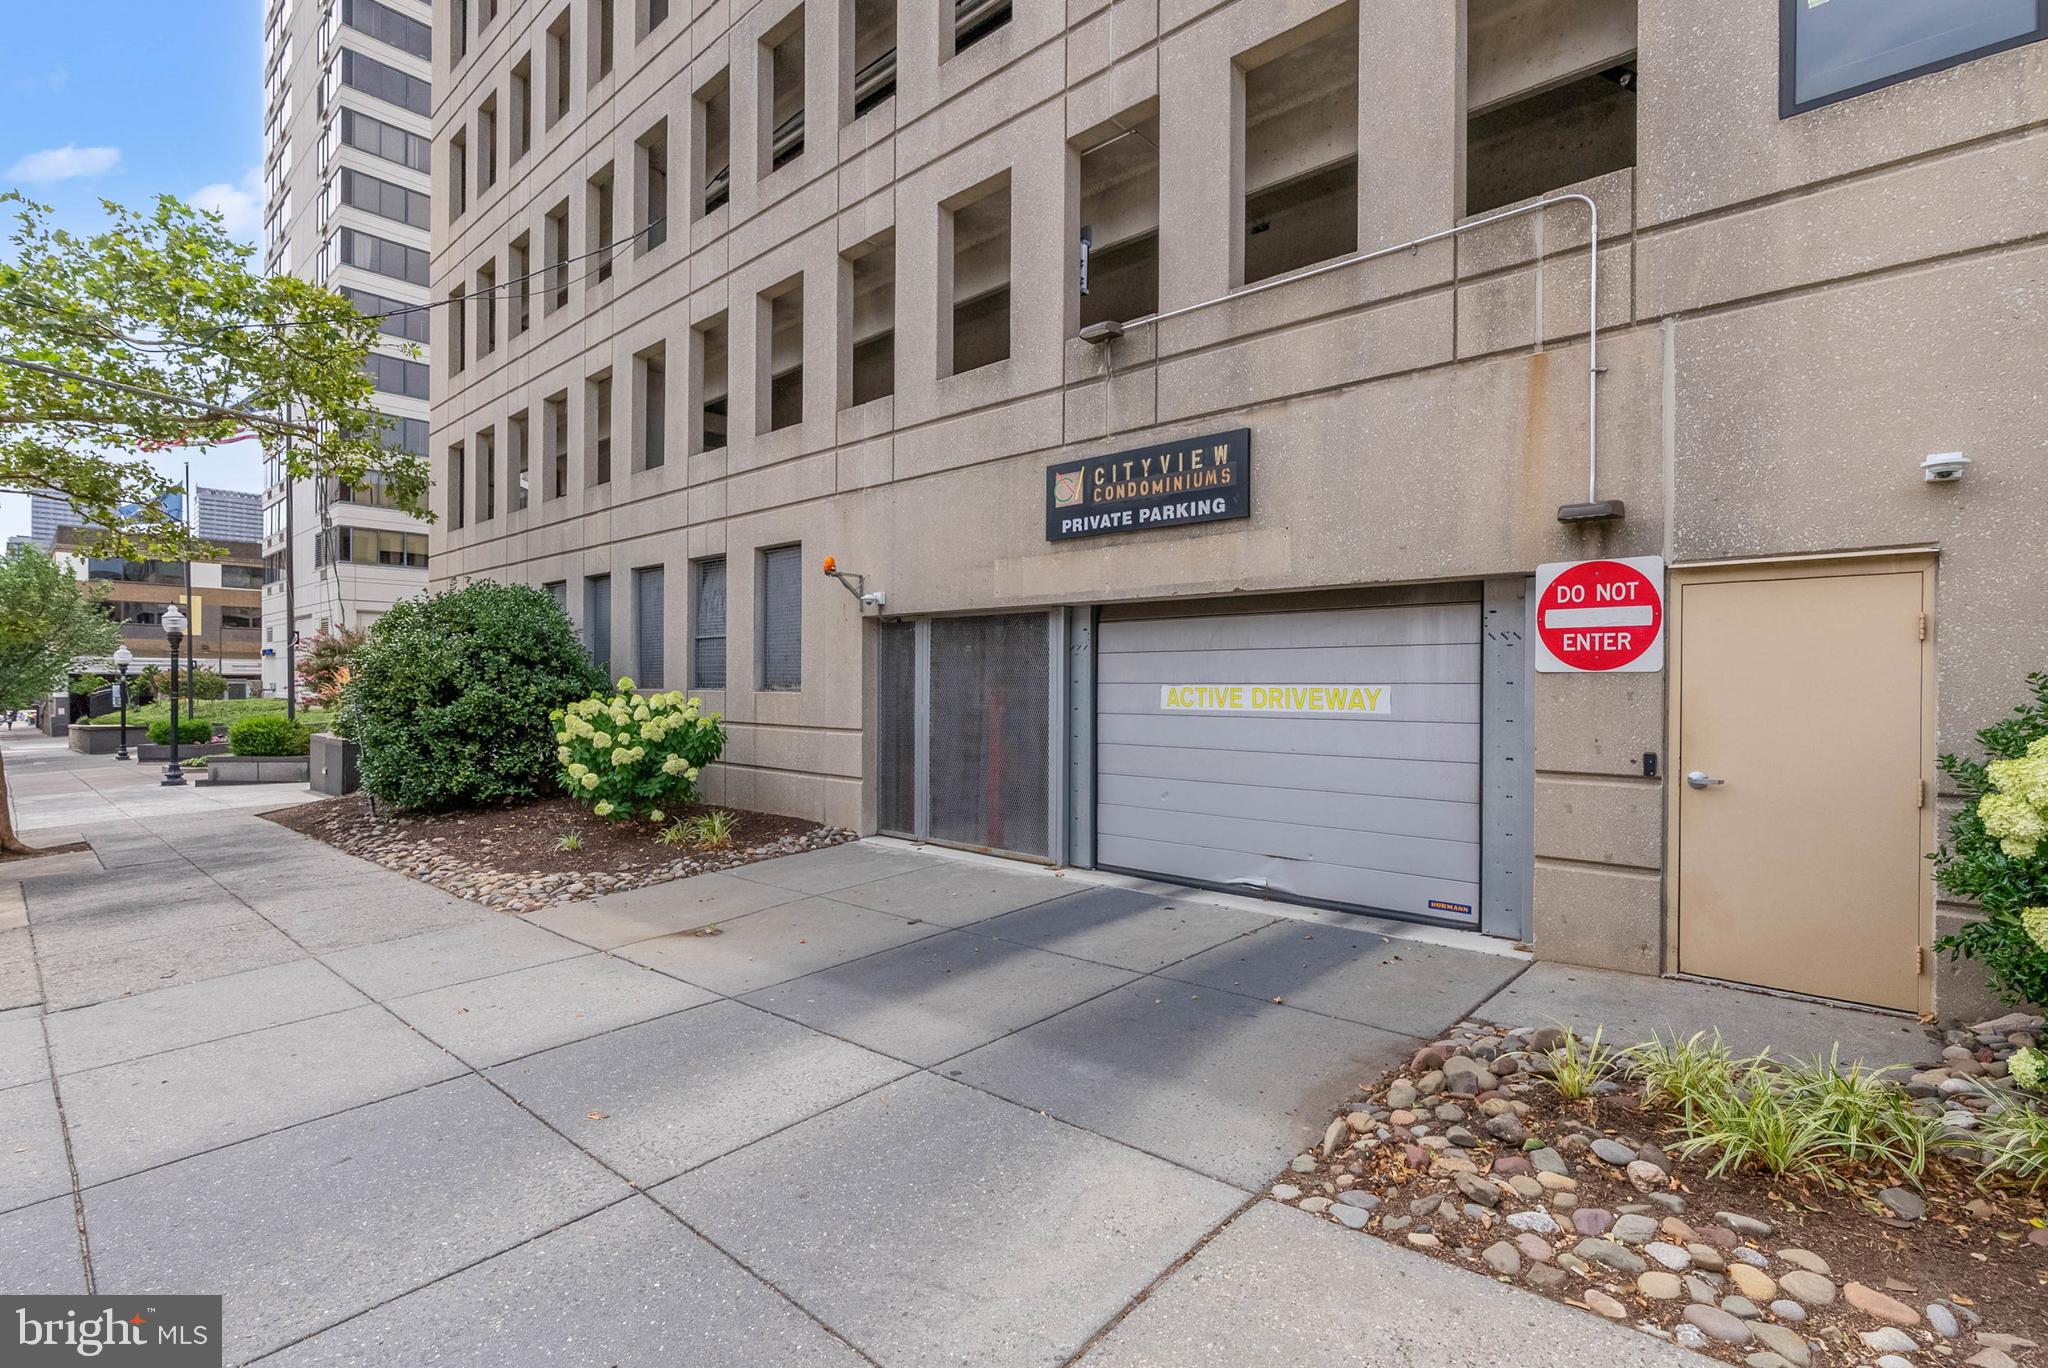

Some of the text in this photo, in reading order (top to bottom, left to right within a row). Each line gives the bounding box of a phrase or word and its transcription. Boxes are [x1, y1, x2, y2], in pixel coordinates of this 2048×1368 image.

[1093, 467, 1231, 502] CONDOMINIUMS
[1062, 498, 1226, 534] PRIVATE PARKING
[1557, 581, 1639, 604] DO NOT
[1563, 632, 1632, 651] ENTER
[1167, 687, 1382, 711] ACTIVE DRIVEWAY
